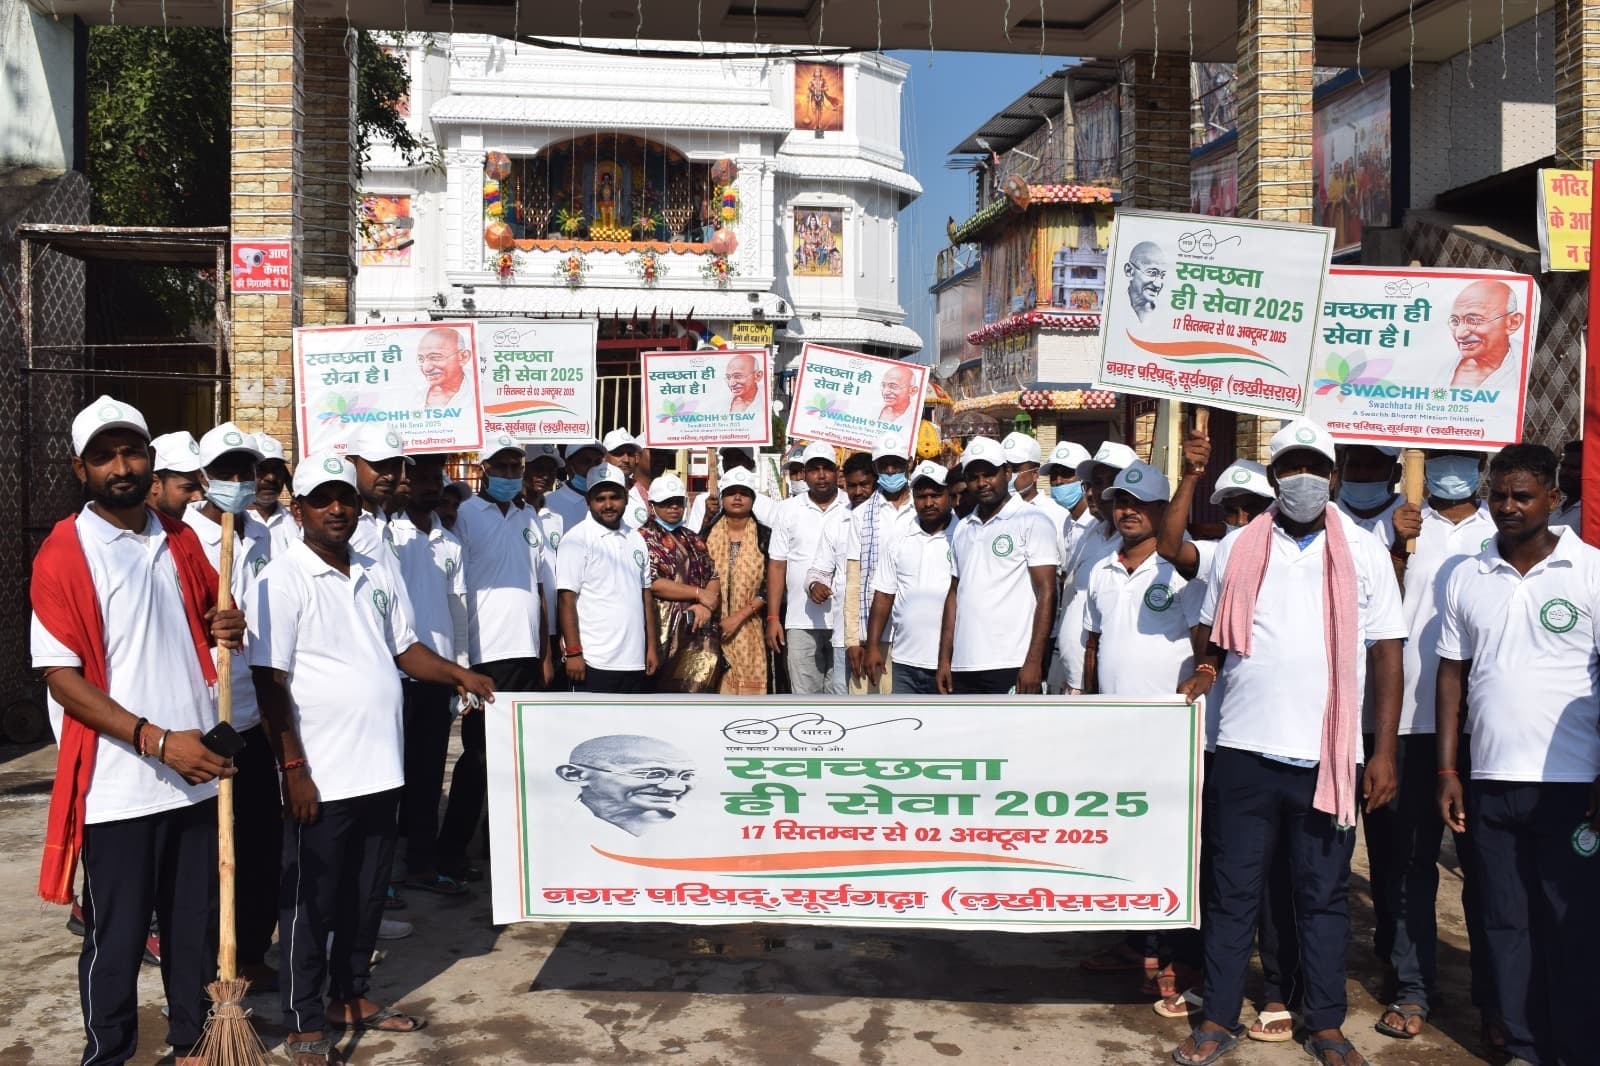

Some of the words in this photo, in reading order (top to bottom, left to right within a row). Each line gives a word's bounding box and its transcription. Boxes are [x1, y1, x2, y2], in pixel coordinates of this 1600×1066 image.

[1551, 173, 1588, 196] मंदिर
[1549, 206, 1564, 229] के
[1569, 212, 1591, 231] आ
[268, 248, 288, 259] आप
[1176, 261, 1264, 289] स्वच्छता
[1170, 283, 1197, 310] ही
[1203, 287, 1251, 317] सेवा
[1253, 297, 1304, 323] 2025
[1323, 301, 1397, 321] वच्छता
[1403, 298, 1432, 323] ही
[1173, 318, 1181, 330] 17
[1183, 314, 1215, 335] सितम्बर
[1216, 319, 1226, 336] से
[1226, 324, 1235, 337] 02
[1237, 325, 1269, 346] अक्टूबर
[1269, 329, 1287, 344] 2025
[1323, 322, 1372, 345] सेवा
[305, 350, 376, 366] स्वच्छता
[381, 344, 402, 362] ही
[493, 350, 554, 363] स्वच्छता
[321, 368, 359, 385] सेवा
[492, 364, 511, 382] ही
[515, 365, 548, 381] सेवा
[551, 367, 584, 382] 2025
[648, 370, 697, 381] स्वच्छता
[701, 366, 715, 380] ही
[806, 362, 854, 380] स्वच्छता
[857, 370, 872, 384] ही
[1106, 361, 1136, 378] नगर
[660, 383, 685, 395] सेवा
[814, 376, 840, 392] सेवा
[1368, 400, 1412, 411] Swachhata
[1415, 402, 1423, 410] Hi
[1425, 402, 1445, 412] Seva
[1447, 403, 1469, 413] 2025
[724, 757, 1008, 781] स्वच्छता
[720, 782, 806, 816] ही
[825, 784, 980, 816] सेवा
[995, 790, 1149, 817] 2025
[741, 825, 766, 840] 17
[773, 819, 877, 841] सितम्बर
[882, 821, 908, 842] से
[914, 827, 942, 842] 02
[950, 827, 1049, 850] अक्टूबर
[1055, 828, 1109, 844] 2025
[542, 887, 639, 904] नगर
[942, 886, 1181, 917] (लखीसराय)
